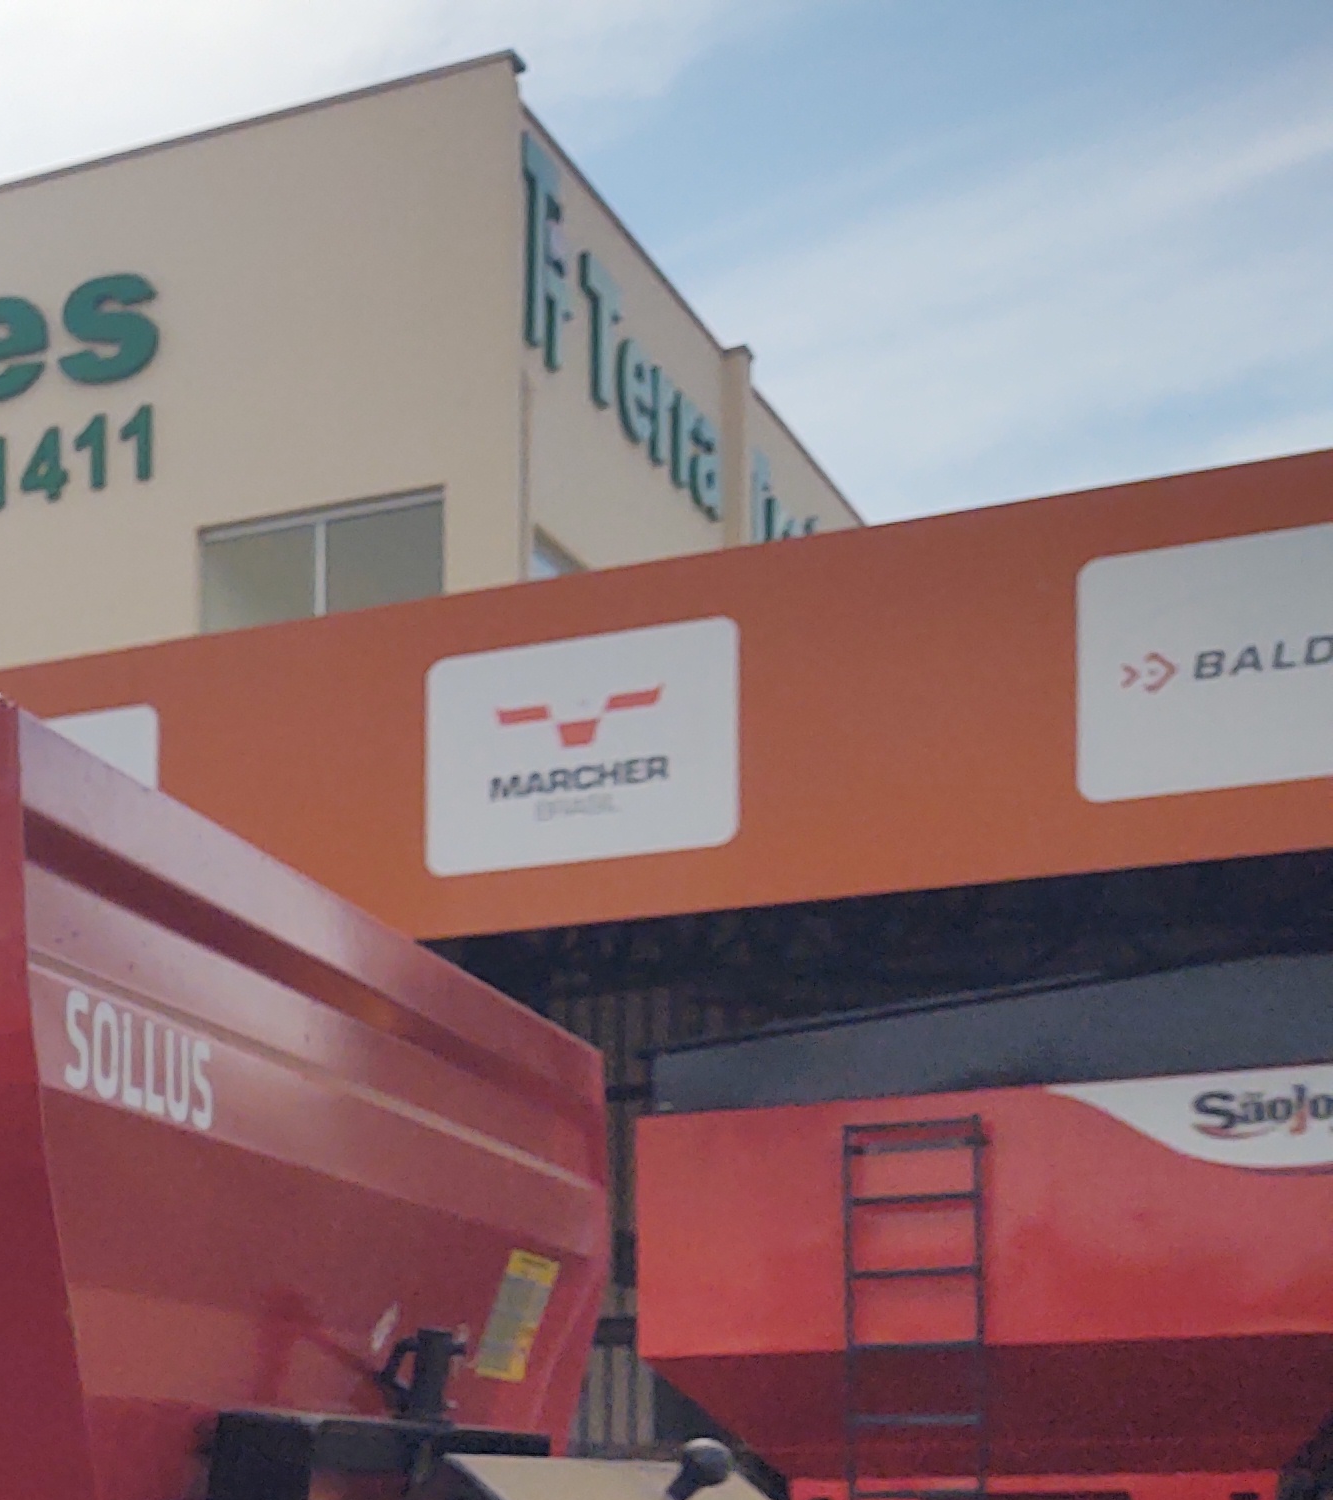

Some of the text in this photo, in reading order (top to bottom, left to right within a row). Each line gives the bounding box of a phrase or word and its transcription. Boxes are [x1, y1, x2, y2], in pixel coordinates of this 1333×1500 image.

[579, 250, 722, 522] Terra
[1194, 635, 1333, 680] BALD
[490, 756, 669, 801] MARCHER
[65, 989, 213, 1131] SOLLUS
